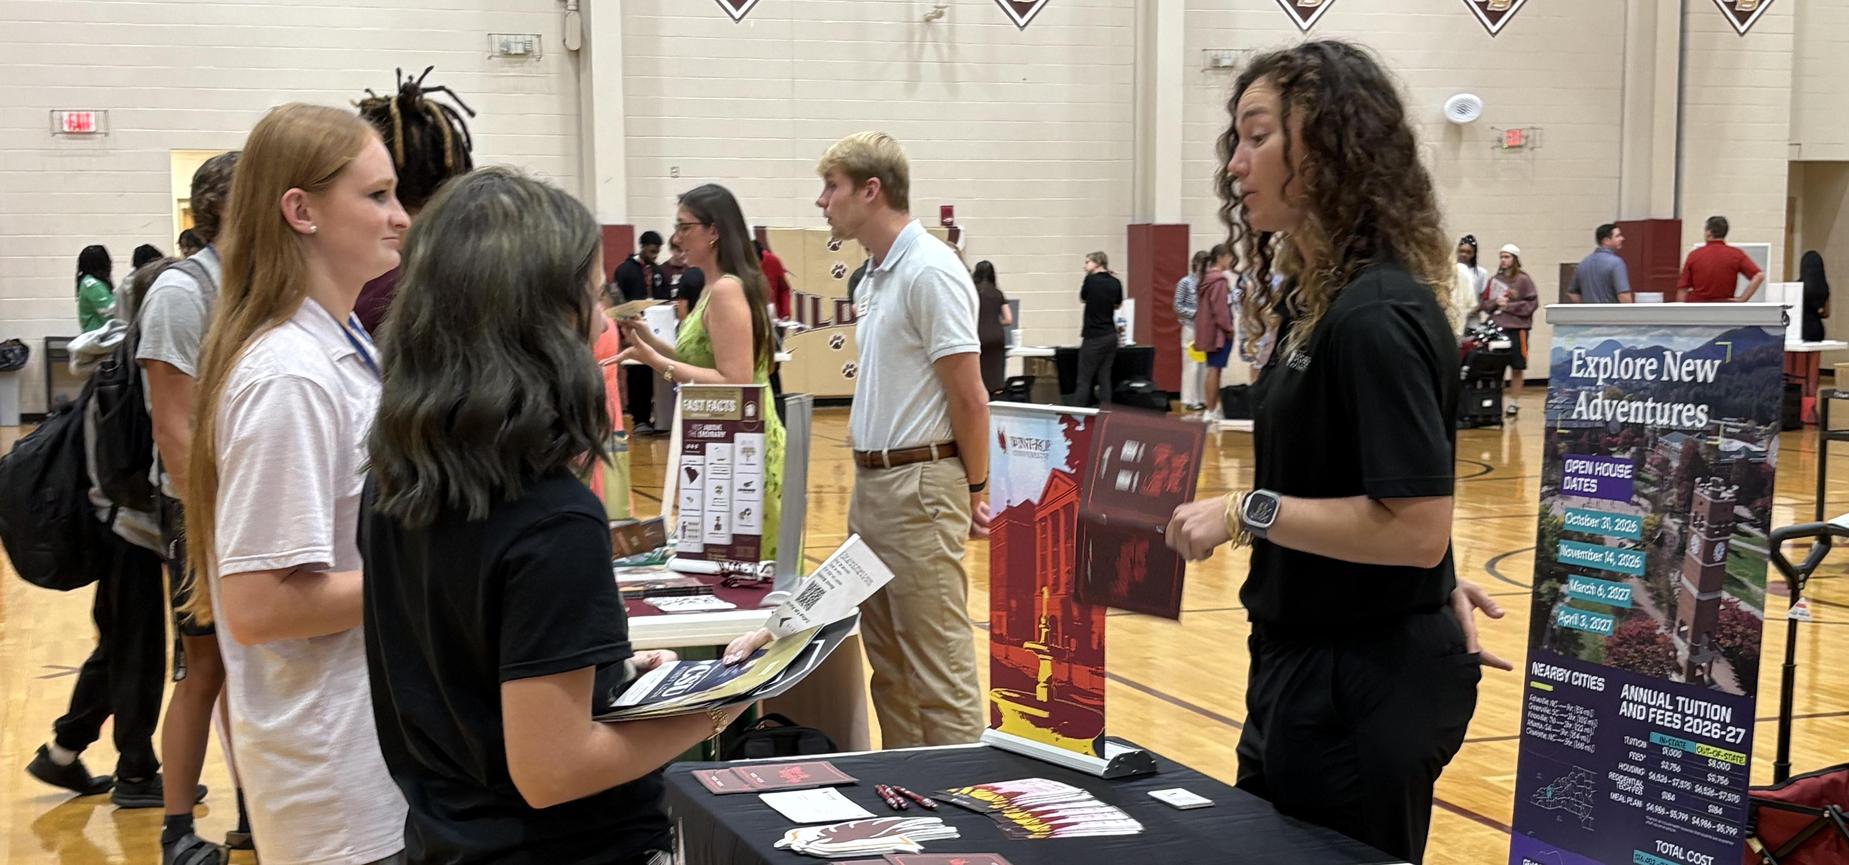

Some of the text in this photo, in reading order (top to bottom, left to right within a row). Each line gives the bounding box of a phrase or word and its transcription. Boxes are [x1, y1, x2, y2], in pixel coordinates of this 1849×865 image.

[1569, 348, 1722, 385] Explore New
[1572, 390, 1710, 428] Adventures
[1564, 459, 1633, 479] OPEN HOUSE
[1563, 476, 1598, 493] DATES
[1565, 511, 1599, 528] October
[1558, 544, 1602, 561] November
[1568, 578, 1596, 595] March
[1607, 585, 1631, 601] 2027
[1557, 610, 1580, 627] April
[1531, 661, 1605, 692] NEARBY CITIES
[1620, 683, 1732, 723] ANNUAL TUITION
[1619, 701, 1746, 744] AND FEES 2026-27
[1655, 840, 1714, 865] TOTAL COST
